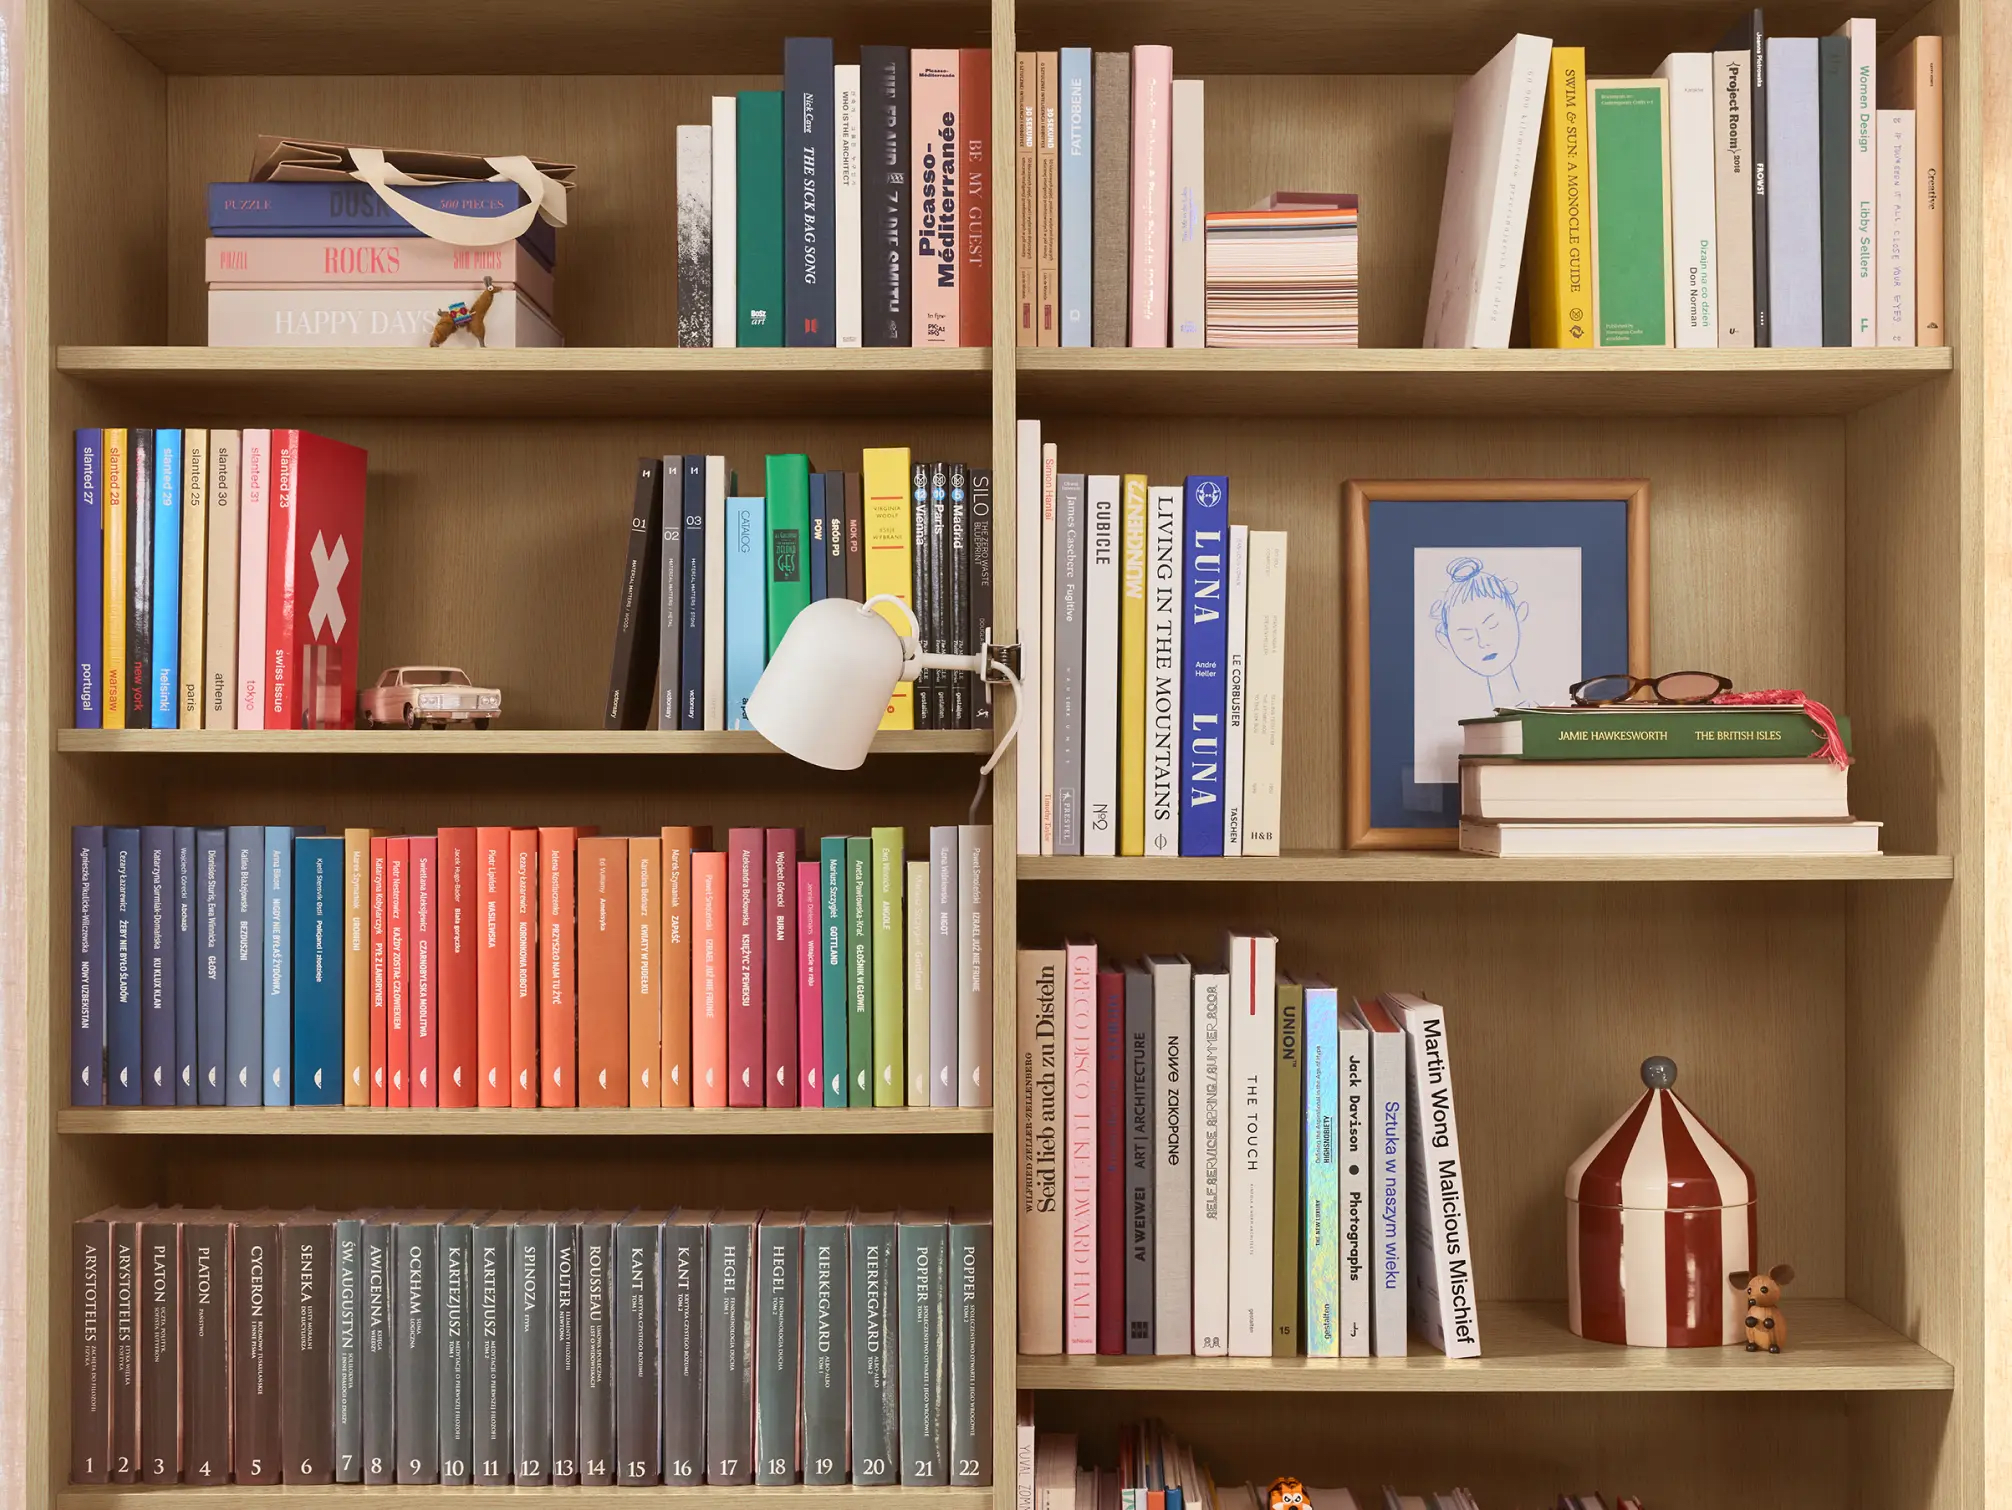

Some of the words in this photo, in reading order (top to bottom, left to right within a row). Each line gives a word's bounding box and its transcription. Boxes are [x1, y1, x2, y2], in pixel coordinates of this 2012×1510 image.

[806, 92, 814, 112] Nick
[1565, 69, 1576, 108] SWIM
[1860, 65, 1870, 109] Women
[804, 113, 814, 134] Cave
[842, 113, 849, 121] IS
[1046, 108, 1054, 118] 30
[1071, 78, 1082, 156] FATTOBENE
[1566, 111, 1576, 124] &
[1046, 118, 1055, 148] SEKUND
[1566, 126, 1578, 158] SUN:
[1858, 114, 1870, 152] Design
[804, 147, 814, 176] THE
[842, 140, 850, 186] ARCHITECT
[969, 140, 982, 162] BE
[1568, 162, 1578, 172] A
[804, 178, 815, 211] SICK
[969, 172, 982, 198] MY
[1756, 163, 1764, 195] FROWST
[224, 200, 269, 210] PUZZLE
[440, 200, 459, 209] 500
[462, 200, 504, 209] PIECES
[918, 143, 936, 256] Picasso-
[938, 112, 955, 288] Méditerranée
[1568, 174, 1580, 244] MONOCLE
[1858, 201, 1870, 232] Libby
[804, 213, 816, 243] BAG
[969, 206, 982, 267] GUEST
[325, 246, 400, 274] ROCKS
[804, 246, 816, 284] SONG
[1569, 248, 1580, 293] GUIDE
[1700, 240, 1709, 270] Dizajn
[1860, 236, 1871, 278] Sellers
[1690, 267, 1698, 286] Don
[1700, 272, 1708, 284] na
[1701, 286, 1708, 299] co
[276, 311, 362, 334] HAPPY
[370, 308, 438, 334] DAYS
[1690, 289, 1698, 327] Norman
[1702, 301, 1710, 327] dzień
[84, 447, 94, 489] slanted
[280, 449, 290, 491] slanted
[84, 491, 94, 505] 27
[279, 492, 290, 508] 23
[973, 476, 990, 516] SILO
[1066, 495, 1077, 528] James
[632, 518, 646, 528] 01
[686, 516, 702, 526] 03
[740, 510, 750, 554] CATALOG
[814, 519, 822, 540] POW
[831, 518, 842, 543] ŚRÓD
[850, 520, 858, 539] MOK
[916, 504, 926, 545] Vienna
[934, 504, 944, 534] Paris
[952, 504, 964, 549] Madrid
[980, 521, 988, 536] THE
[1096, 501, 1111, 564] CUBICLE
[832, 544, 840, 556] PD
[850, 540, 858, 552] PD
[974, 522, 982, 565] BLUEPRINT
[980, 537, 988, 558] ZERO
[1066, 529, 1077, 578] Casebere
[1157, 496, 1173, 580] LIVING
[981, 559, 990, 586] WASTE
[1194, 530, 1221, 624] LUNA
[1064, 584, 1076, 622] Fugitive
[1156, 587, 1172, 613] IN
[1156, 620, 1172, 670] THE
[1232, 654, 1241, 666] LE
[274, 649, 284, 680] swiss
[1195, 670, 1216, 678] Heller
[80, 664, 93, 710] portugal
[109, 670, 118, 711] warsaw
[160, 668, 170, 711] helsinki
[186, 684, 196, 712] paris
[244, 680, 256, 711] tokyo
[274, 683, 284, 712] issue
[1231, 668, 1241, 727] CORBUSIER
[1154, 676, 1171, 820] MOUNTAINS
[1558, 731, 1588, 740] JAMIE
[1591, 731, 1668, 740] HAWKESWORTH
[1694, 731, 1715, 740] THE
[1717, 731, 1754, 740] BRITISH
[1756, 730, 1782, 740] ISLES
[1191, 713, 1218, 808] LUNA
[1230, 808, 1238, 843] TASCHEN
[1251, 832, 1272, 840] H&B
[240, 921, 248, 960] BEZDUSZNI
[488, 901, 496, 948] WASILEWSKA
[776, 916, 784, 940] BURAN
[153, 958, 162, 968] KU
[830, 926, 838, 966] GOTTLAND
[81, 961, 90, 983] NOWY
[153, 969, 162, 988] KLUX
[208, 956, 216, 980] GŁOSY
[81, 984, 90, 1028] UZBEKISTAN
[154, 989, 162, 1008] KLAN
[742, 972, 750, 1006] PEWEKSU
[1036, 965, 1054, 1040] Disteln
[1042, 1043, 1055, 1068] zu
[1423, 1018, 1445, 1084] Martin
[1349, 1055, 1362, 1087] Jack
[1036, 1072, 1055, 1122] auch
[1247, 1075, 1258, 1106] THE
[1349, 1095, 1362, 1152] Davison
[1385, 1102, 1400, 1154] Sztuka
[1430, 1090, 1452, 1149] Wong
[1036, 1126, 1056, 1164] lieb
[1247, 1113, 1258, 1170] TOUCH
[1385, 1159, 1396, 1173] w
[1036, 1167, 1056, 1213] Seid
[1438, 1159, 1464, 1255] Malicious
[1134, 1187, 1146, 1243] WEIWEI
[1382, 1178, 1396, 1238] naszym
[342, 1241, 356, 1264] ŚW.
[1346, 1192, 1363, 1281] Photographs
[632, 1248, 644, 1291] KANT
[724, 1246, 736, 1294] HEGEL
[1134, 1246, 1146, 1262] AI
[1385, 1242, 1400, 1289] wieku
[154, 1246, 166, 1302] PLATON
[251, 1246, 263, 1316] CYCERON
[301, 1244, 312, 1302] SENEKA
[370, 1245, 382, 1327] AWICENNA
[410, 1246, 422, 1314] OCKHAM
[524, 1246, 536, 1311] SPINOZA
[560, 1247, 571, 1308] WOLTER
[590, 1246, 602, 1320] ROUSSEAU
[916, 1247, 928, 1302] POPPER
[85, 1244, 96, 1341] ARYSTOTELES
[342, 1268, 354, 1348] AUGUSTYN
[448, 1248, 460, 1336] KARTEZJUSZ
[818, 1246, 830, 1352] KIERKEGAARD
[1449, 1259, 1475, 1345] Mischief
[154, 1458, 164, 1474] 3
[198, 1460, 212, 1477] 4
[342, 1455, 352, 1471] 7
[720, 1460, 738, 1476] 17
[863, 1458, 884, 1475] 20
[960, 1459, 980, 1474] 22
